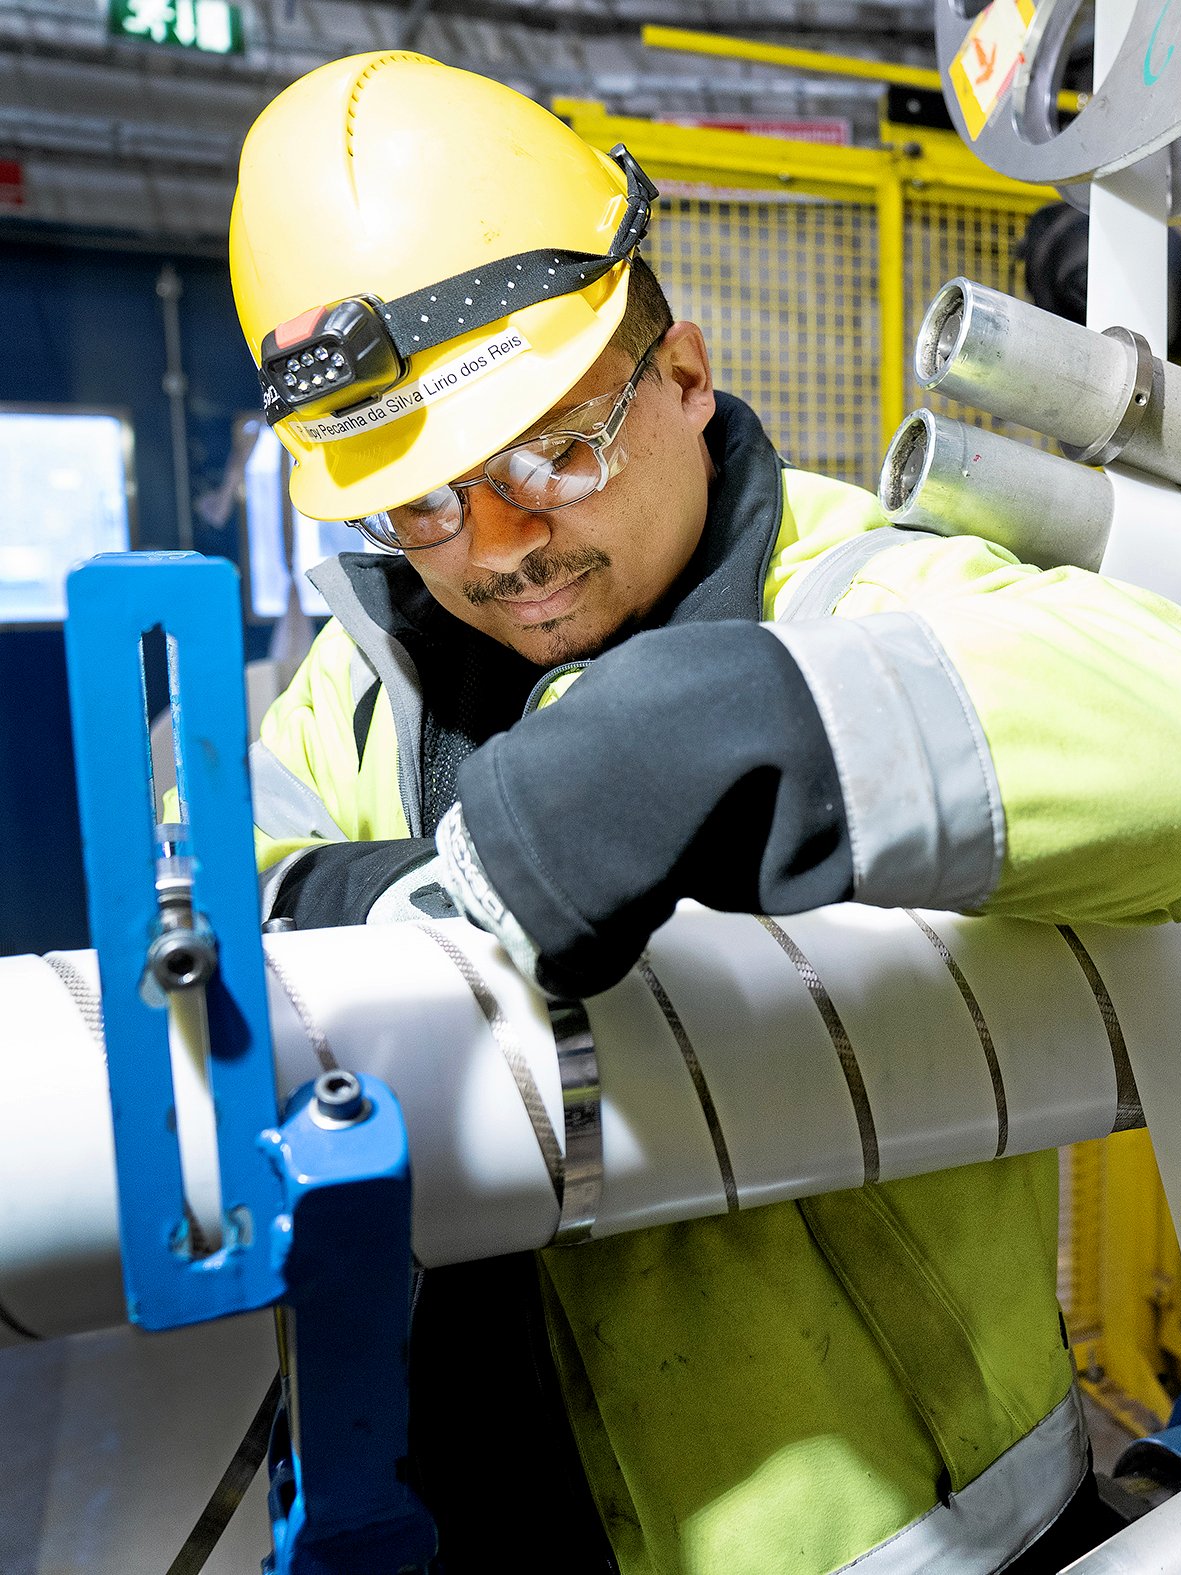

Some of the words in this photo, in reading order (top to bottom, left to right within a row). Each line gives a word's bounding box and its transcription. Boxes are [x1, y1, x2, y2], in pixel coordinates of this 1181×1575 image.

[318, 416, 368, 437] Pecanha
[367, 408, 387, 422] da
[386, 391, 423, 413] Silva
[423, 374, 458, 396] Lirio
[460, 356, 488, 377] dos
[487, 336, 522, 360] Reis
